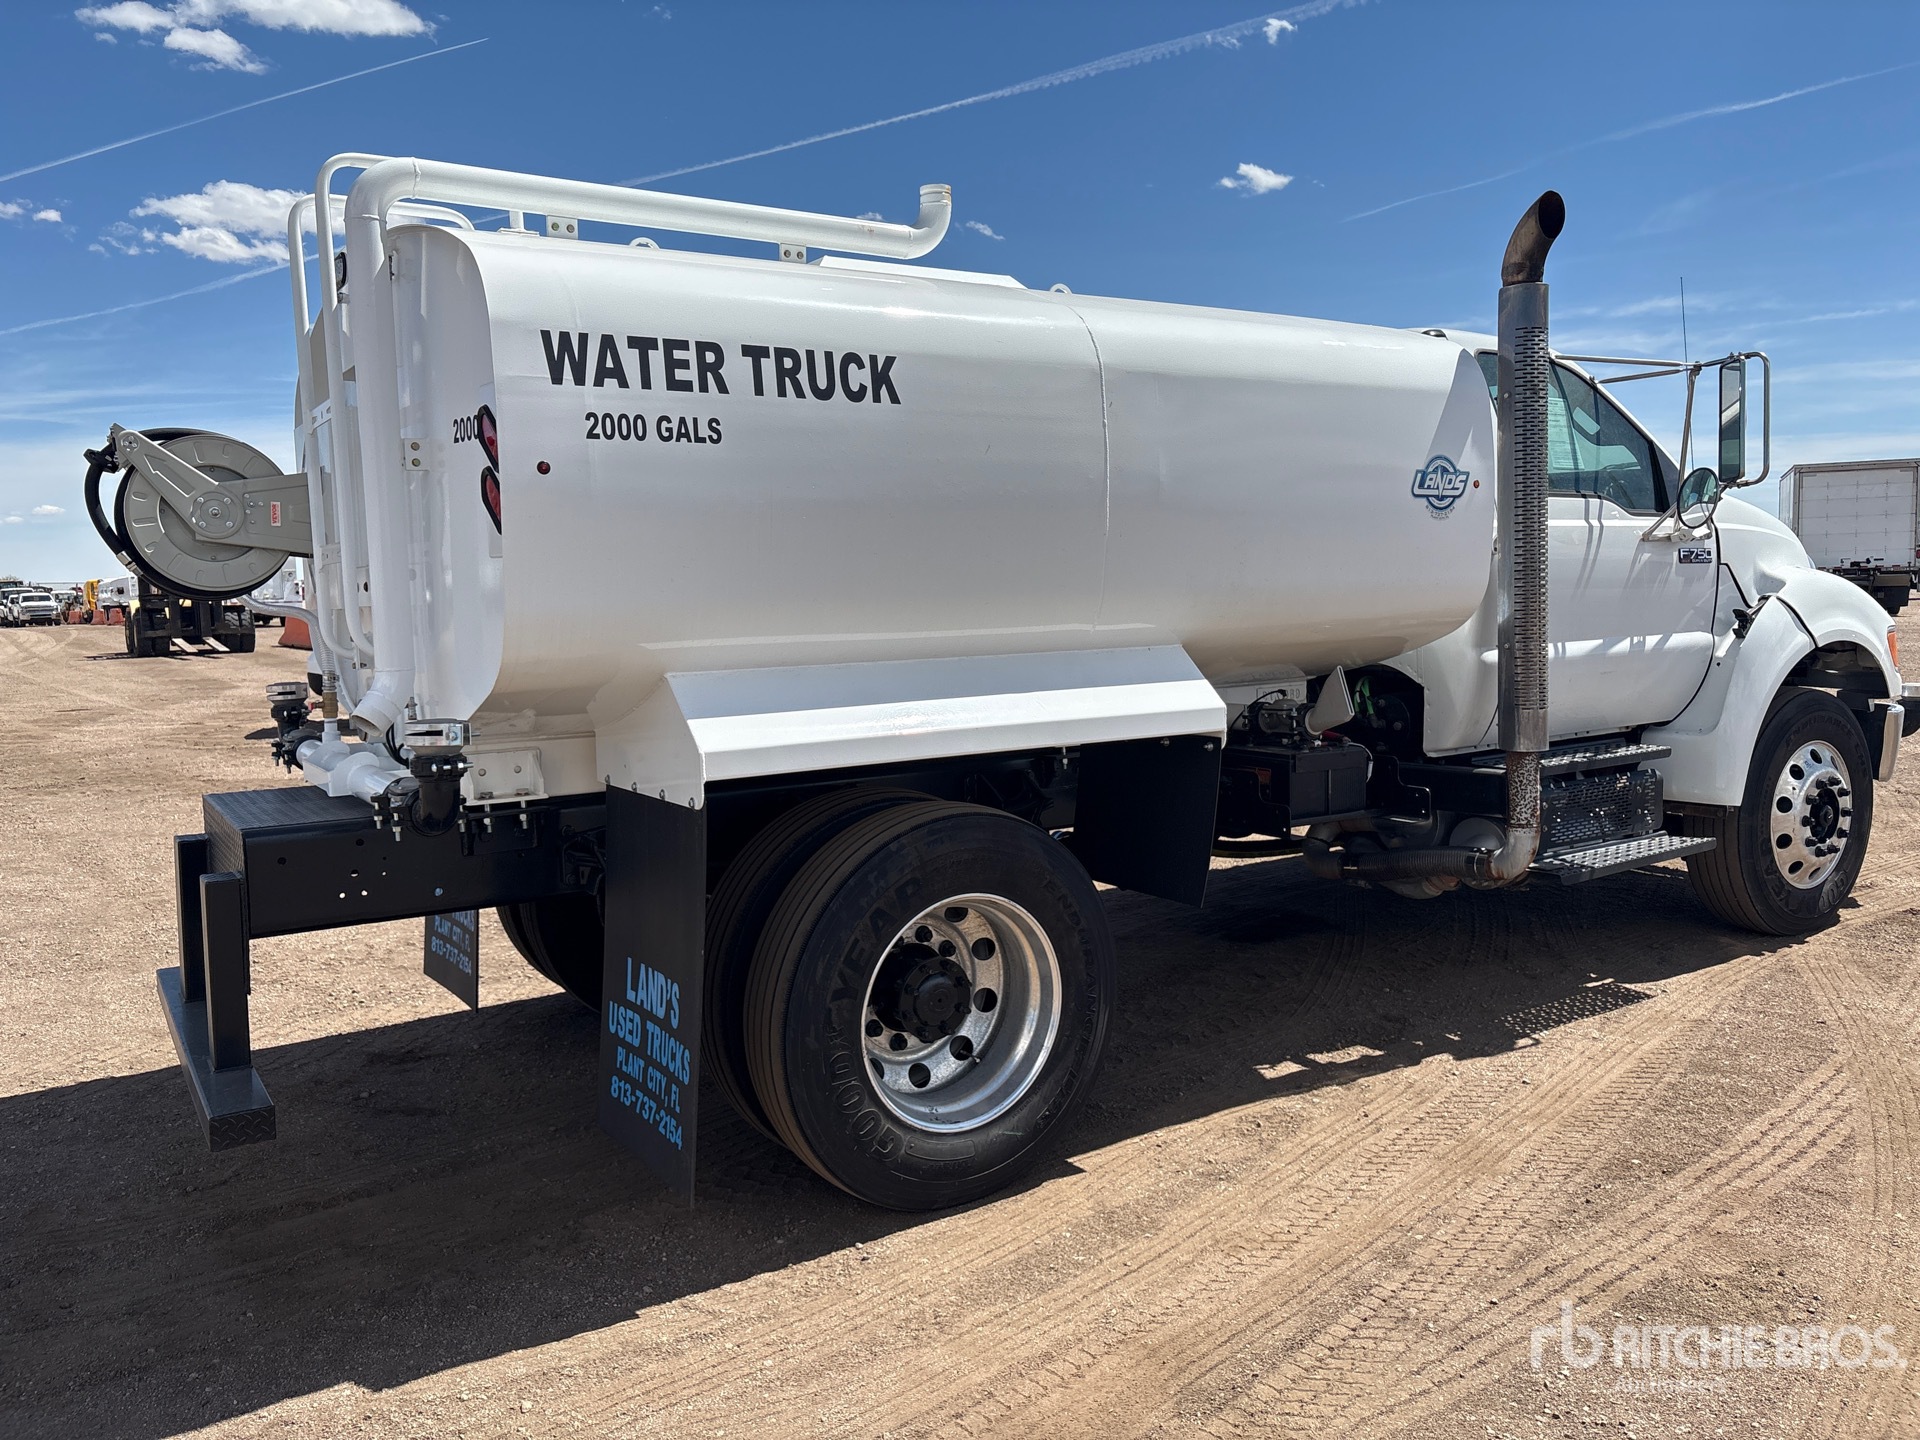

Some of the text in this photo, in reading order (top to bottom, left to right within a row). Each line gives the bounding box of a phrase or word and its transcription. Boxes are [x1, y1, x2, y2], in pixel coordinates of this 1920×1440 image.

[540, 329, 902, 405] WATER TRUCK
[453, 414, 479, 444] 2000
[586, 411, 722, 444] 2000 GALS
[431, 935, 472, 977] 813-737-2154
[626, 956, 680, 1030] LAND'S
[608, 1000, 691, 1086] USED TRUCKS
[610, 1075, 683, 1150] 813-737-2154
[617, 1046, 681, 1113] PLANT CITY, FL
